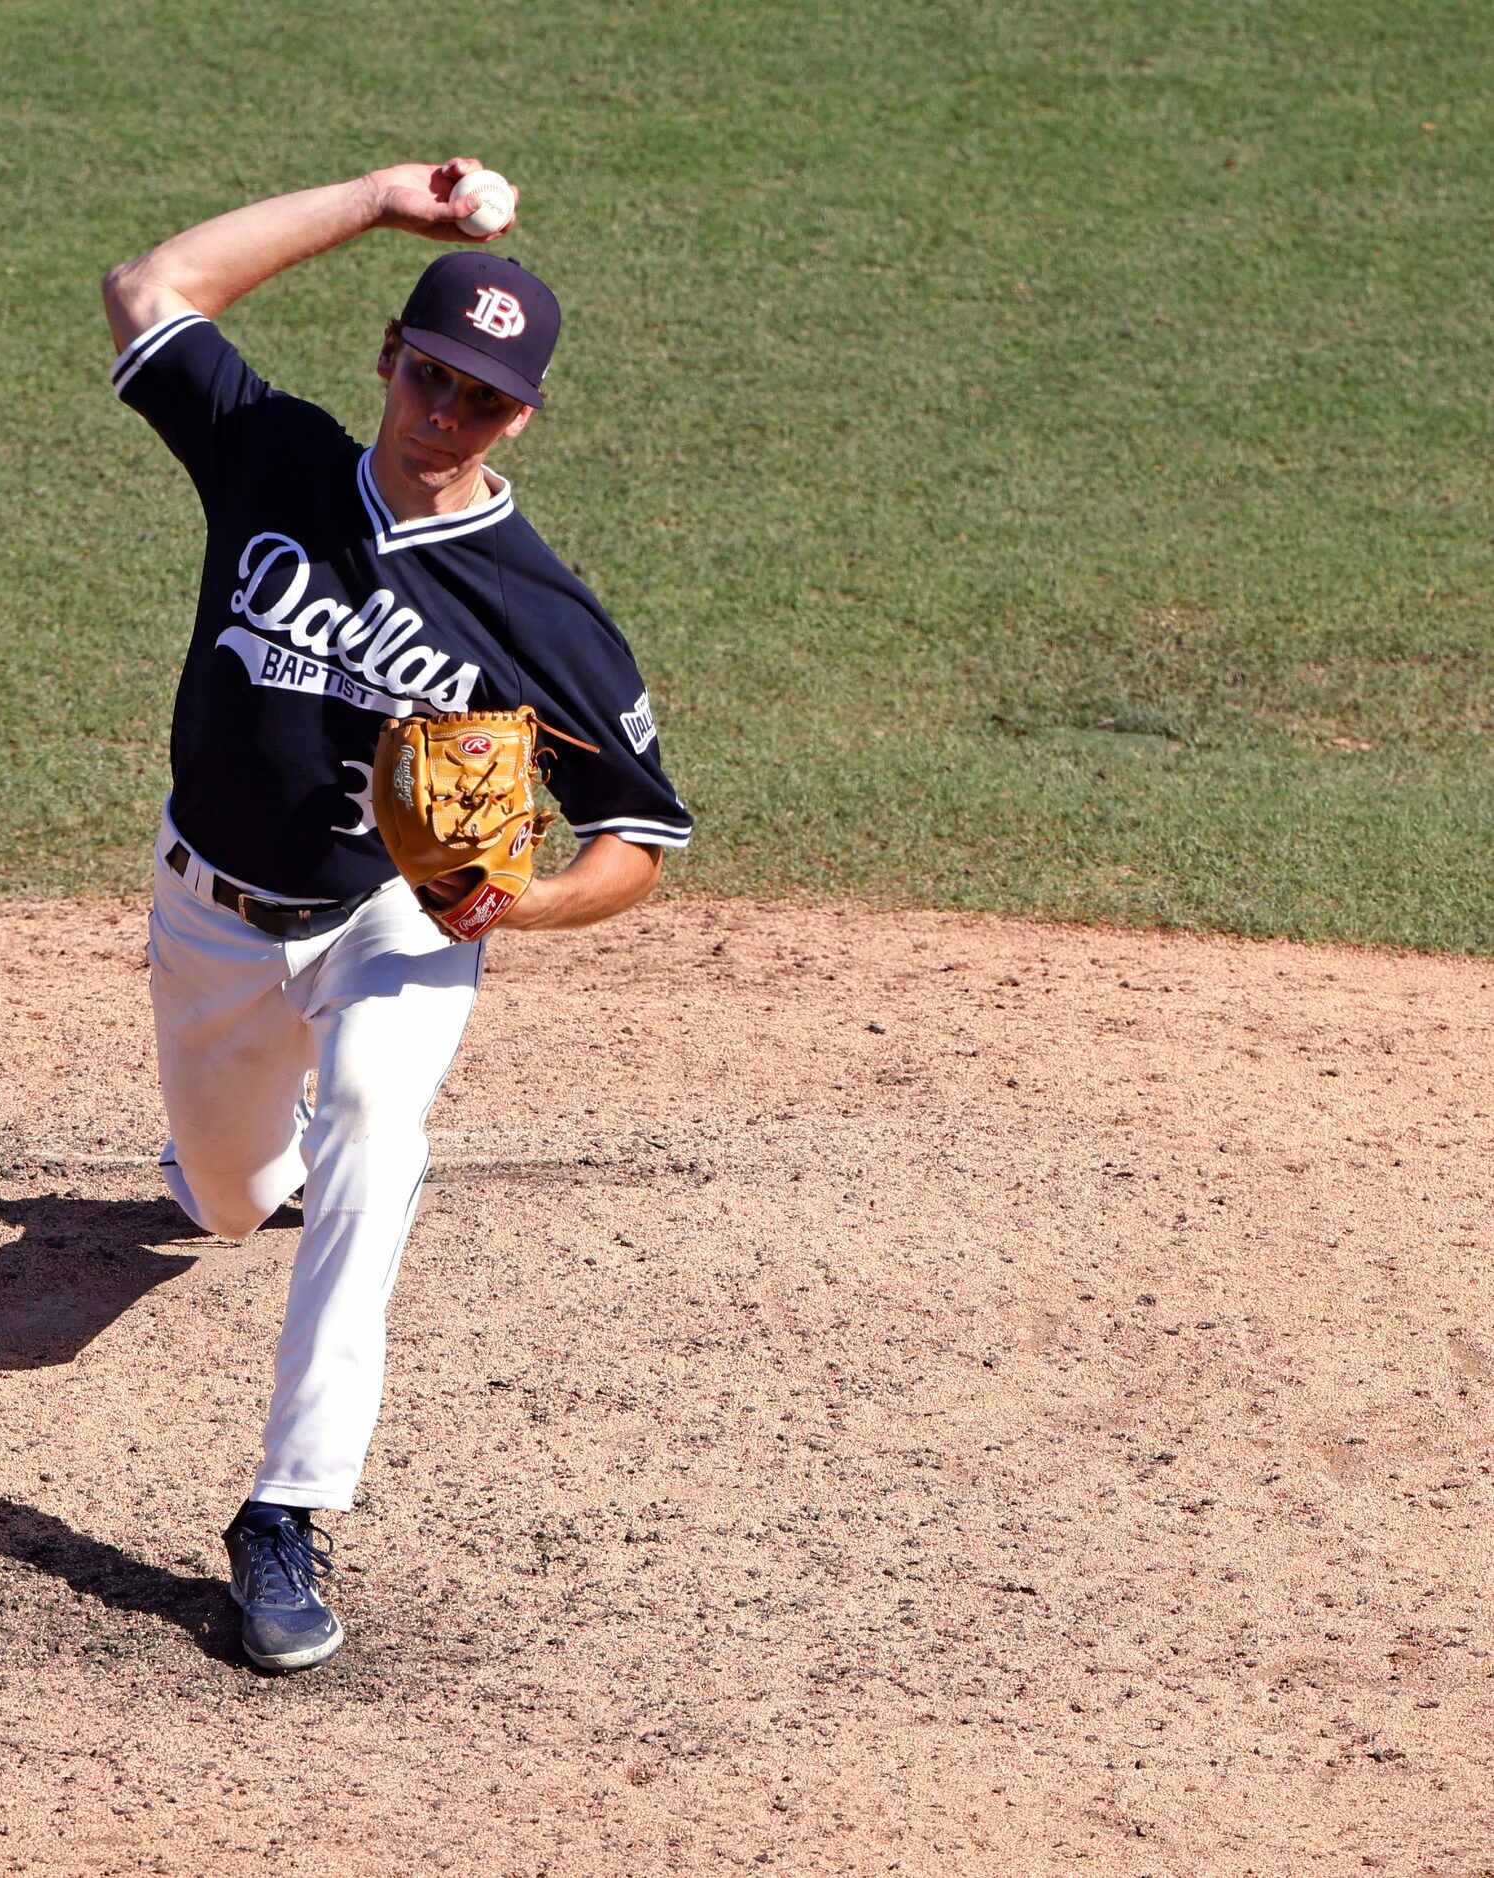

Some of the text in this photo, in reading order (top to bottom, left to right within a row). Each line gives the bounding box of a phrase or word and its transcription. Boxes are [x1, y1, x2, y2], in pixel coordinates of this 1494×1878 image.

[231, 532, 480, 713] Dallas
[260, 646, 373, 704] BAPTIST
[396, 745, 416, 811] Rawlings
[458, 891, 496, 931] Rawlings
